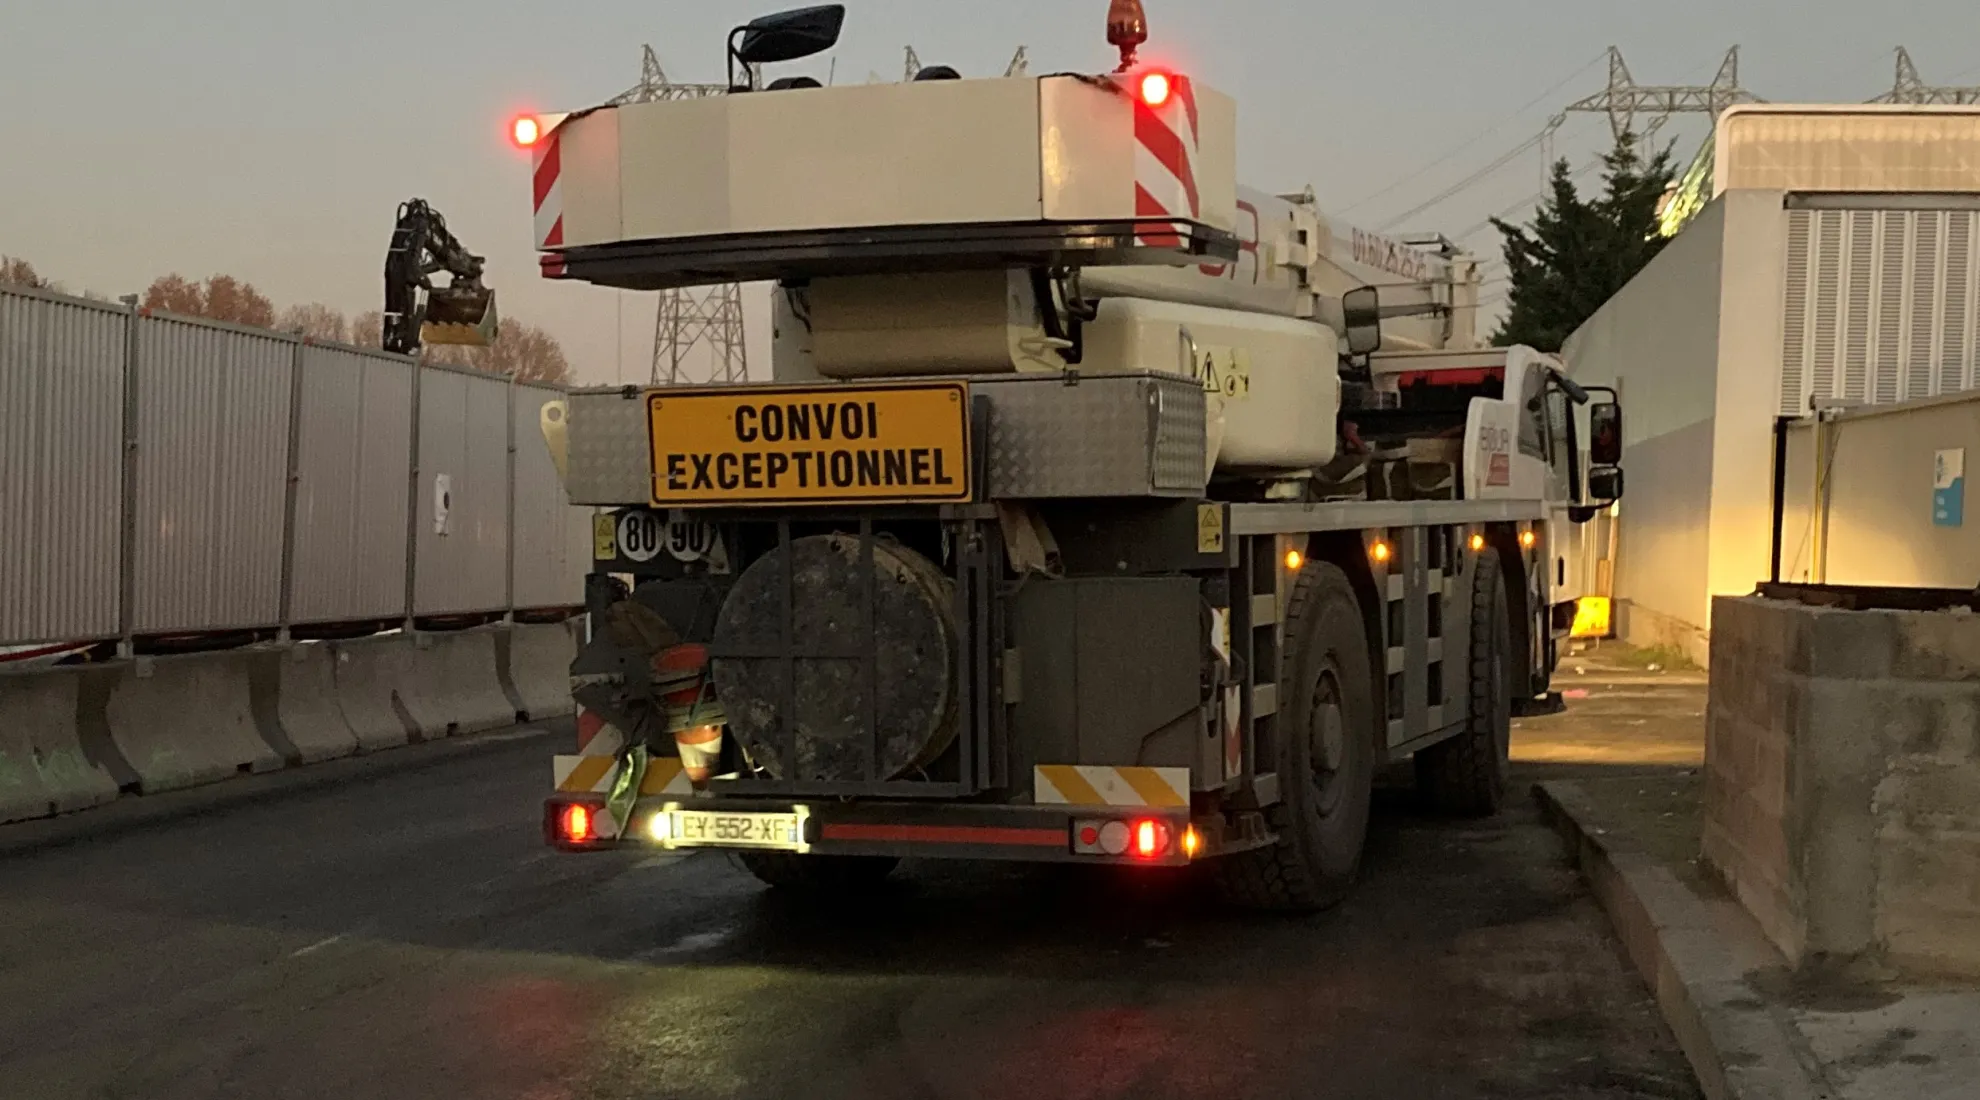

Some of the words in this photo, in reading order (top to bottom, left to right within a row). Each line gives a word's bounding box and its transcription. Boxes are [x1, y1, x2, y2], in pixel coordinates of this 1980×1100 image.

[735, 401, 878, 443] CONVOI
[667, 447, 953, 490] EXCEPTIONNEL
[626, 516, 656, 552] 80
[671, 520, 704, 552] 90
